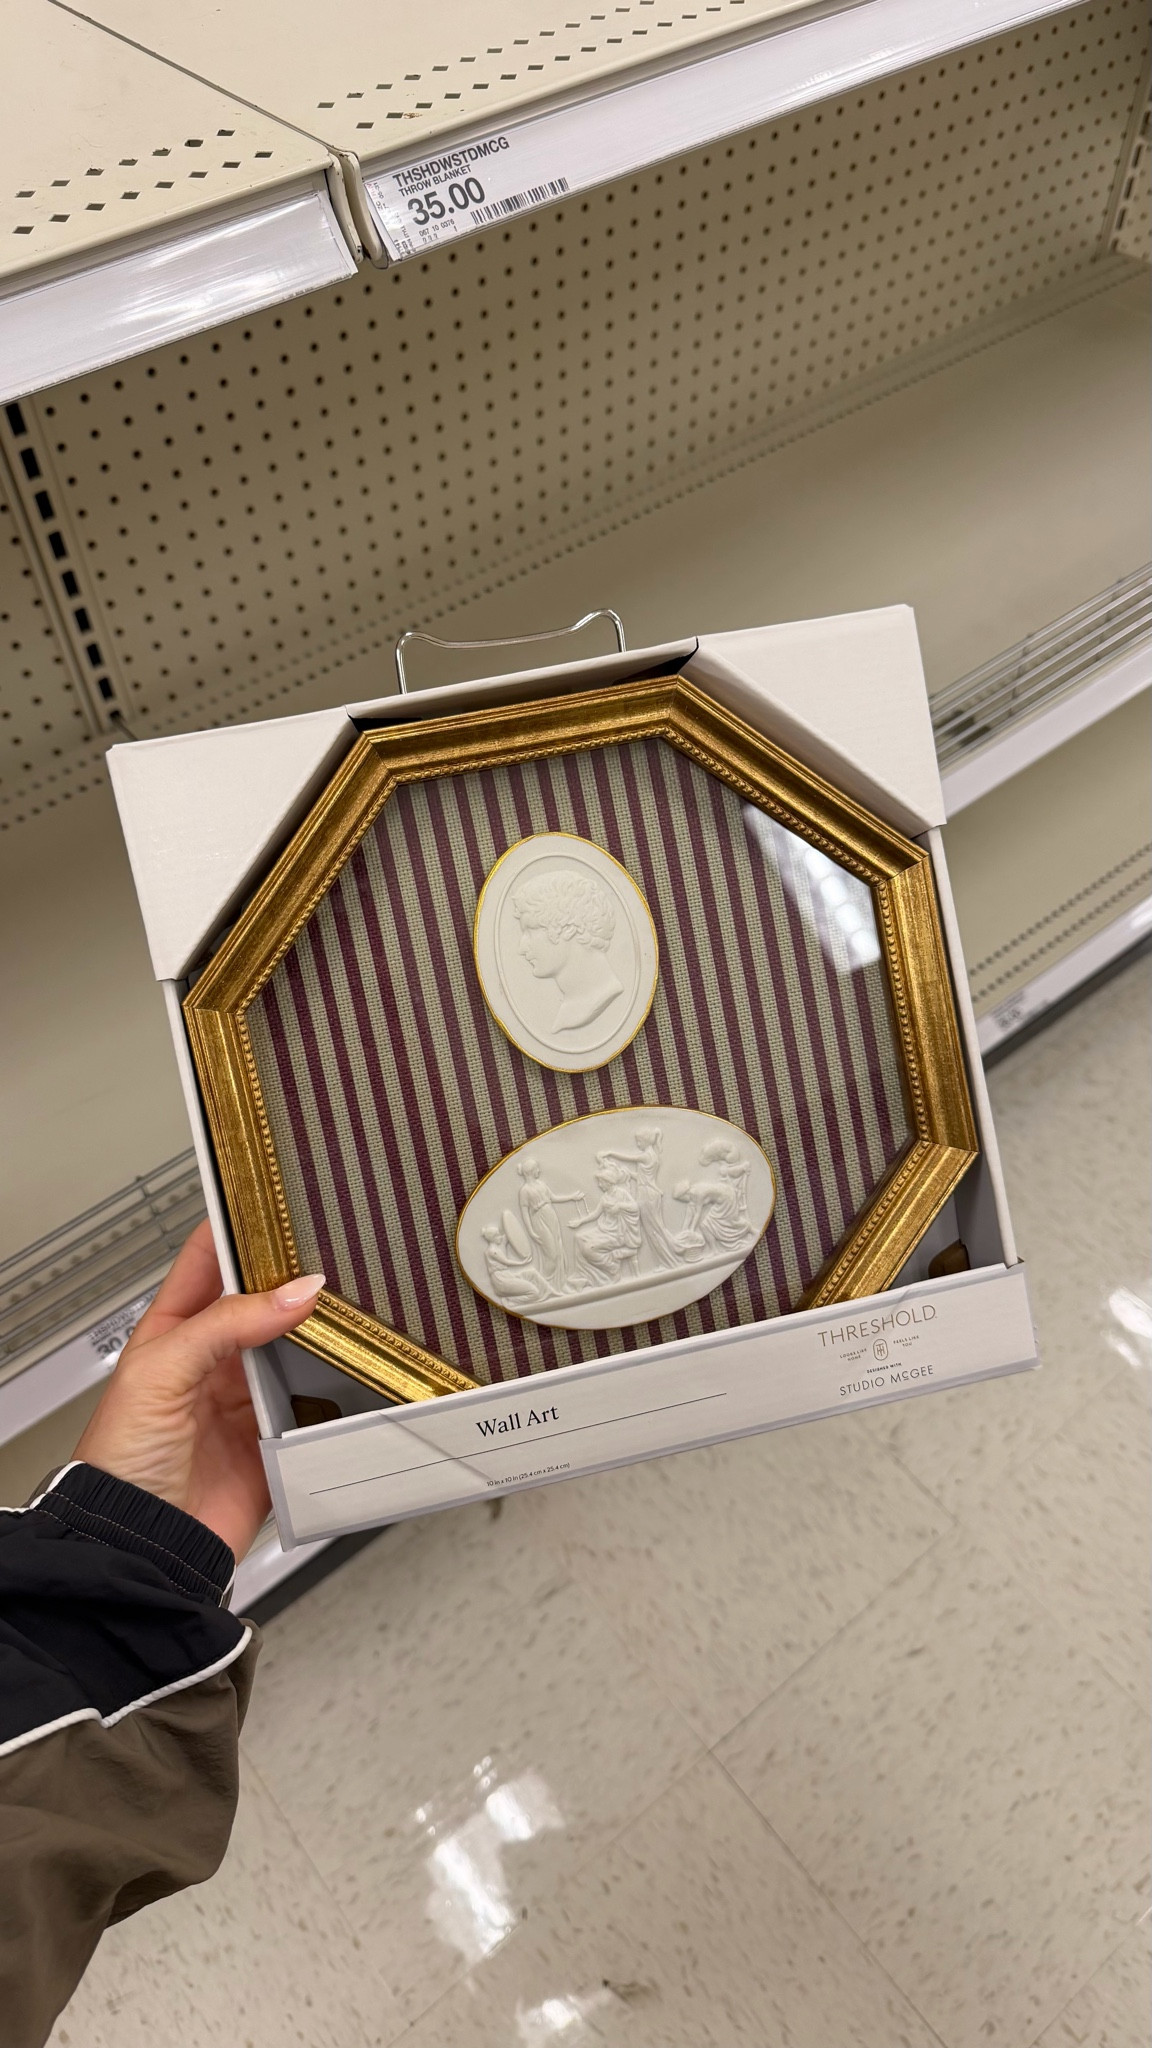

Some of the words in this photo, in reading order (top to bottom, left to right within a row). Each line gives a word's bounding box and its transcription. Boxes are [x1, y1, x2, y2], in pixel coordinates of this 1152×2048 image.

[392, 137, 510, 188] THSHDWSTDMCG
[398, 178, 432, 197] THROW
[432, 164, 472, 185] BLANKET
[407, 177, 485, 226] 35.00
[817, 1304, 937, 1347] THRESHOLD
[839, 1376, 885, 1396] STUDIO
[475, 1412, 521, 1437] Wall
[526, 1406, 560, 1427] Art
[547, 1465, 559, 1473] 25.4
